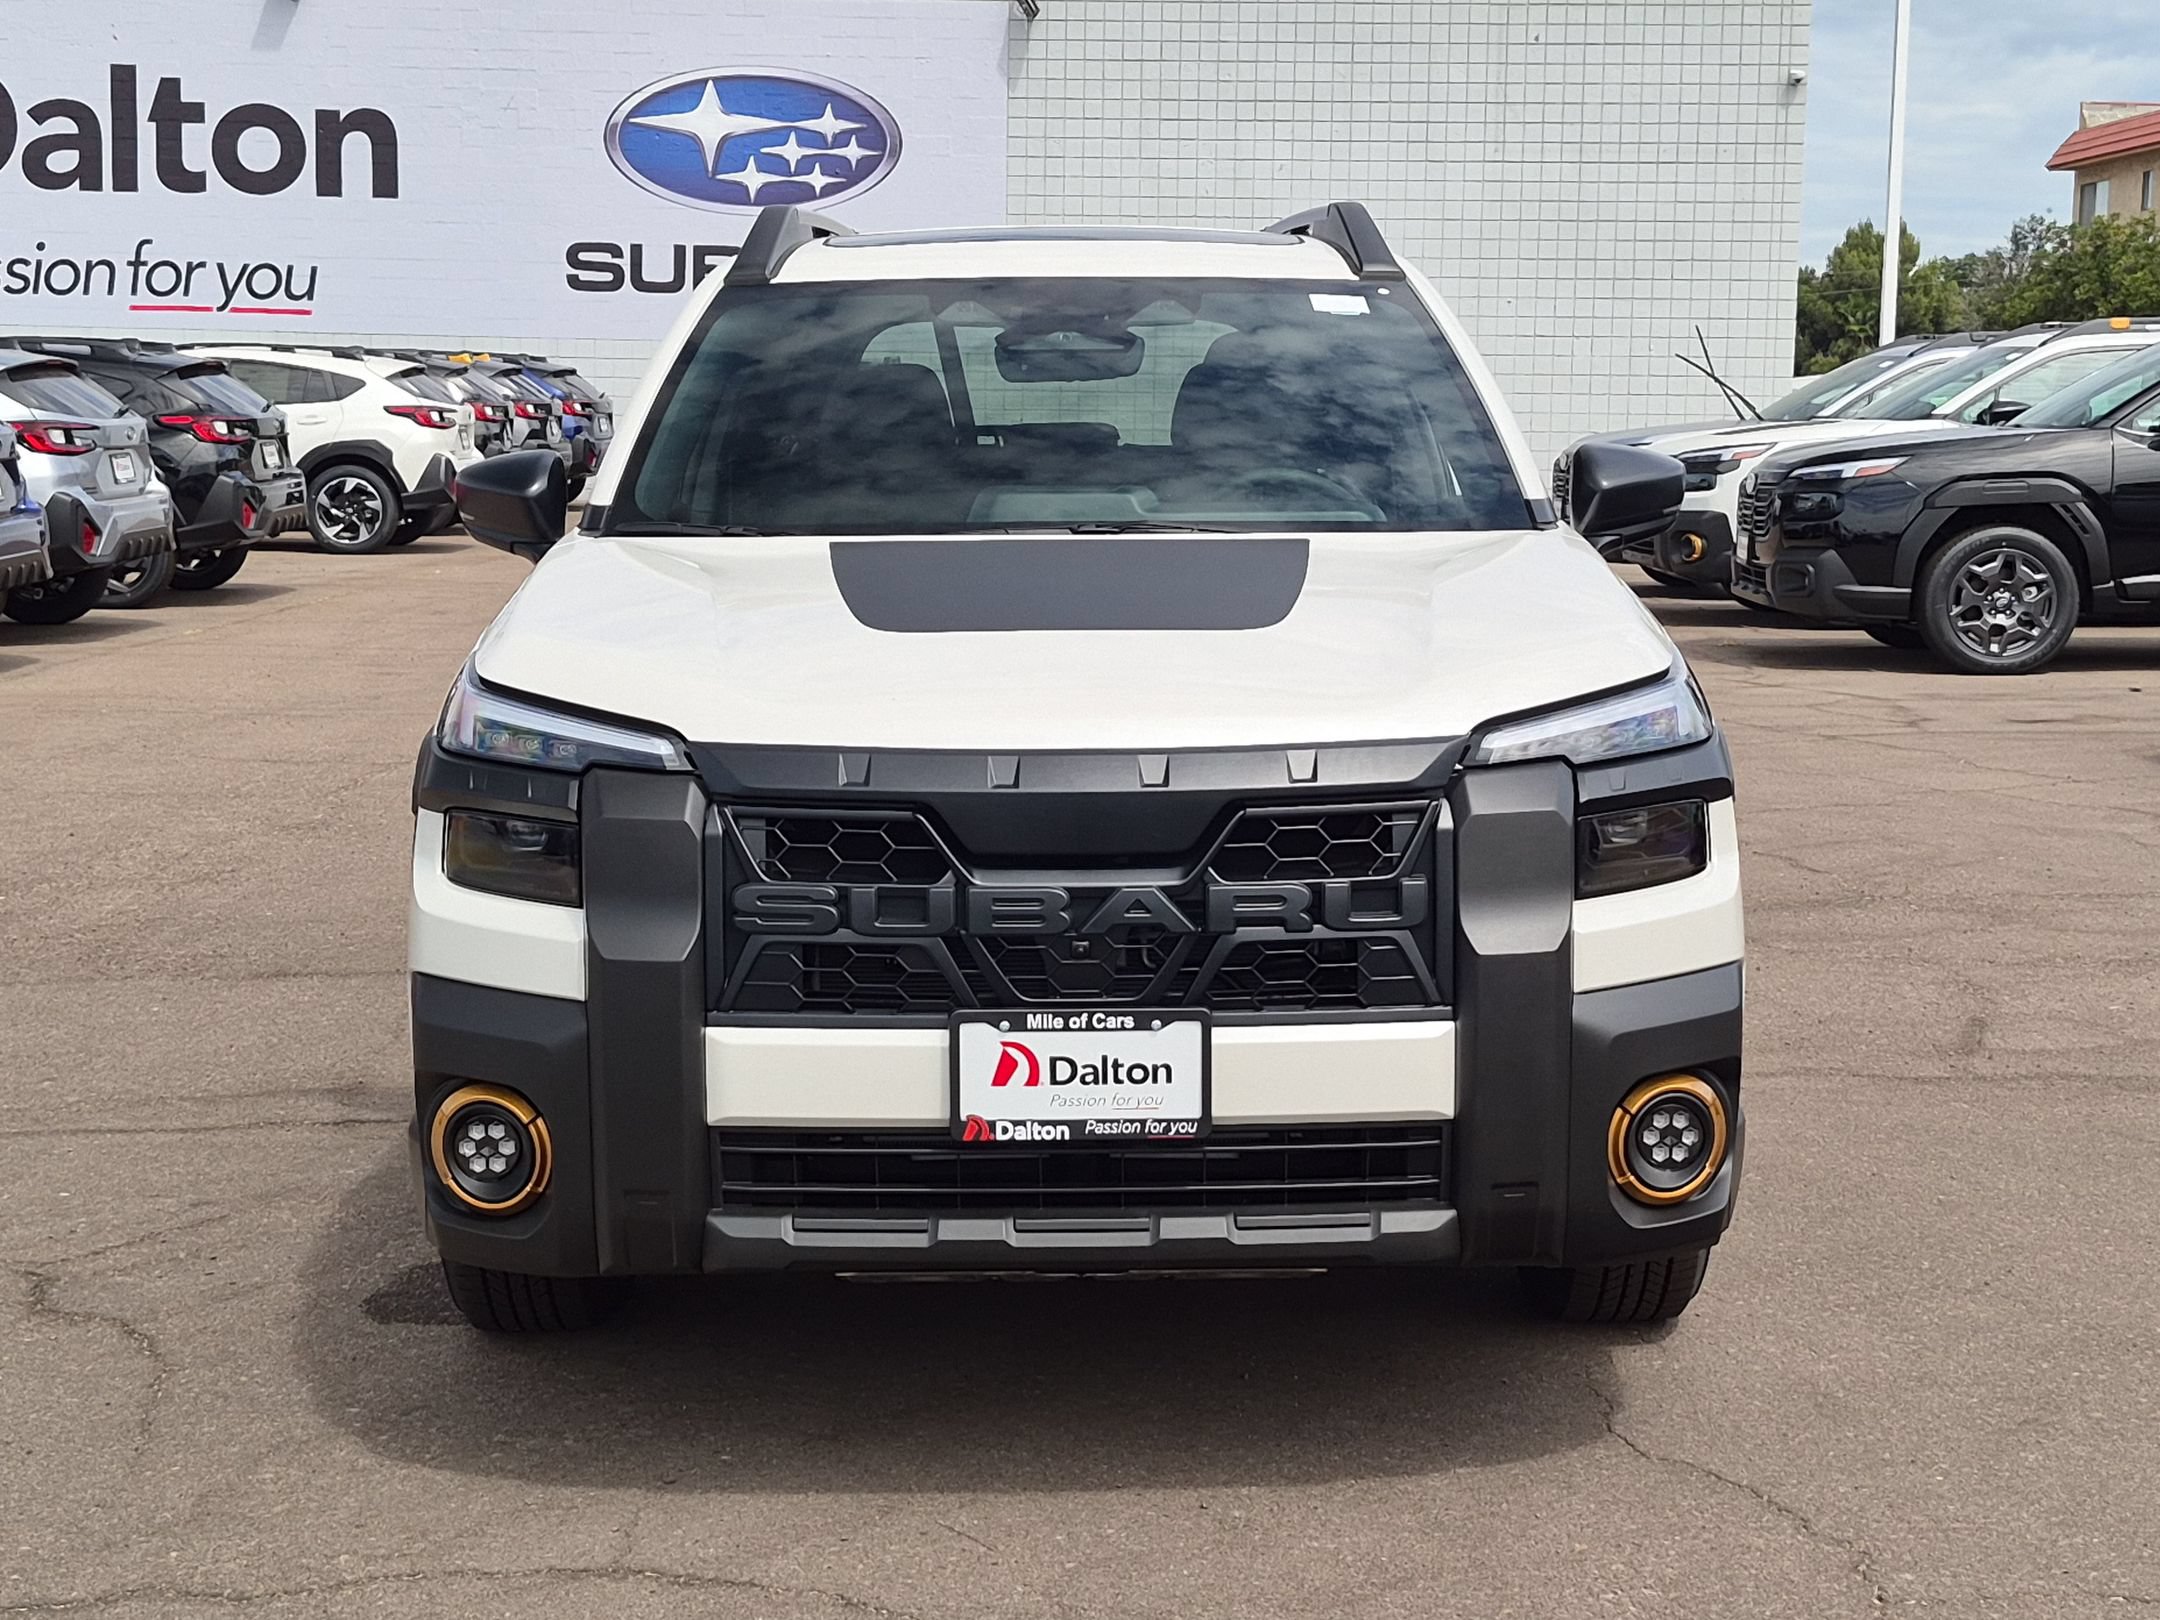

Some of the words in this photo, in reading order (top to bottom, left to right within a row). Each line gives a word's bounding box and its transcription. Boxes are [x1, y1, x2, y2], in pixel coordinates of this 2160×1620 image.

[0, 64, 399, 199] alton
[0, 241, 116, 296] sion
[127, 238, 207, 297] for
[216, 262, 318, 312] you
[733, 874, 1430, 935] SUBARU
[1026, 1013, 1063, 1029] Mile
[1068, 1013, 1088, 1029] of
[1092, 1014, 1135, 1029] Cars
[1049, 1055, 1173, 1086] Dalton
[1049, 1094, 1106, 1107] Passion
[1111, 1093, 1132, 1107] for
[1136, 1095, 1164, 1109] you
[995, 1121, 1070, 1141] Dalton
[1085, 1120, 1140, 1134] Passion
[1144, 1120, 1166, 1134] for
[1169, 1121, 1198, 1135] you
